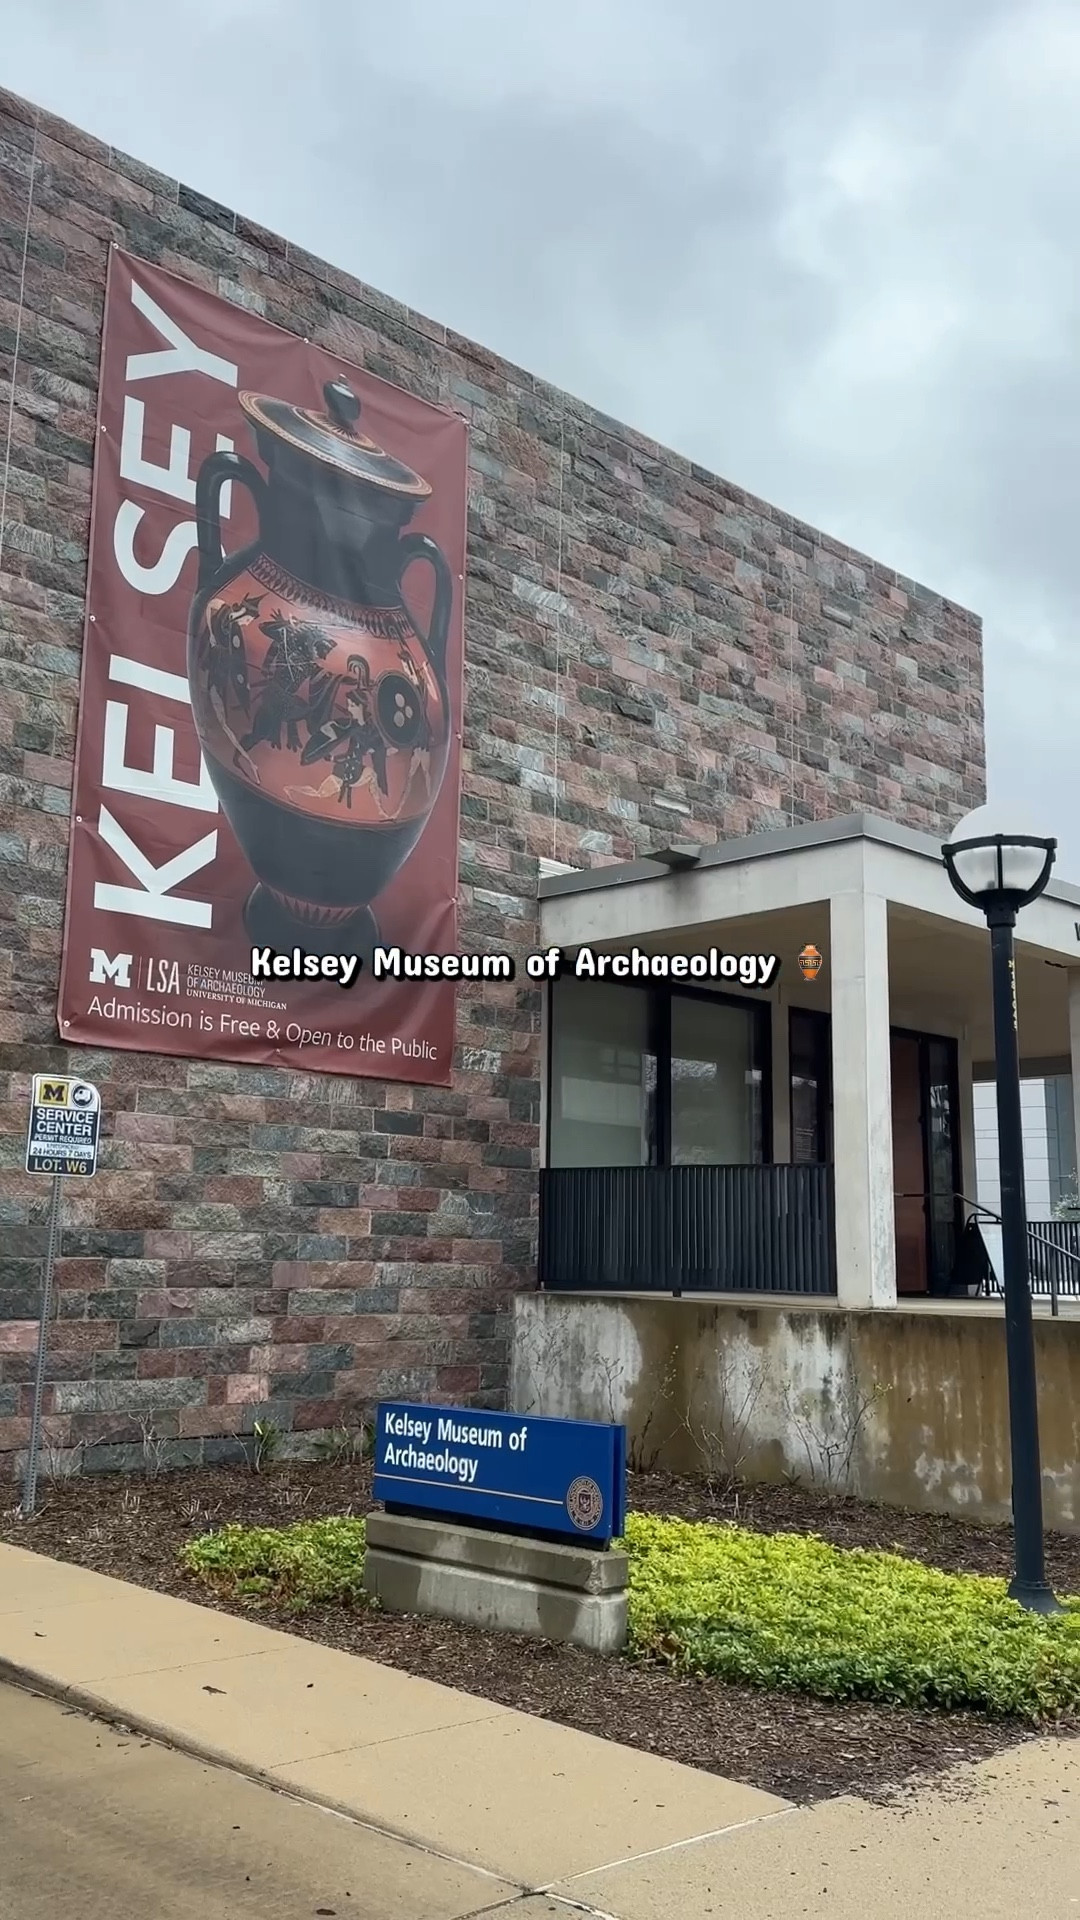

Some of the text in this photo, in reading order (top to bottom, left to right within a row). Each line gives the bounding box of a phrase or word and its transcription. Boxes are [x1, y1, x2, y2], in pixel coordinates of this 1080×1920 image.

[89, 948, 133, 988] M
[146, 957, 180, 995] LSA
[187, 963, 221, 980] KELSEY
[186, 975, 266, 999] OF ARCHAEOLOGY
[186, 988, 287, 1010] UNIVERSITY OF MICHIGAN
[87, 995, 438, 1061] Admission is Free & Open to the Public
[42, 1083, 65, 1102] M
[36, 1107, 94, 1124] SERVICE
[36, 1120, 92, 1136] CENTER
[34, 1133, 92, 1144] PERMIT REQUIRED
[32, 1146, 92, 1159] 24 HOURS 7 DAYS
[66, 1159, 87, 1173] W6
[384, 1412, 528, 1451] Kelsey Museum of
[384, 1442, 479, 1482] Archaeology
